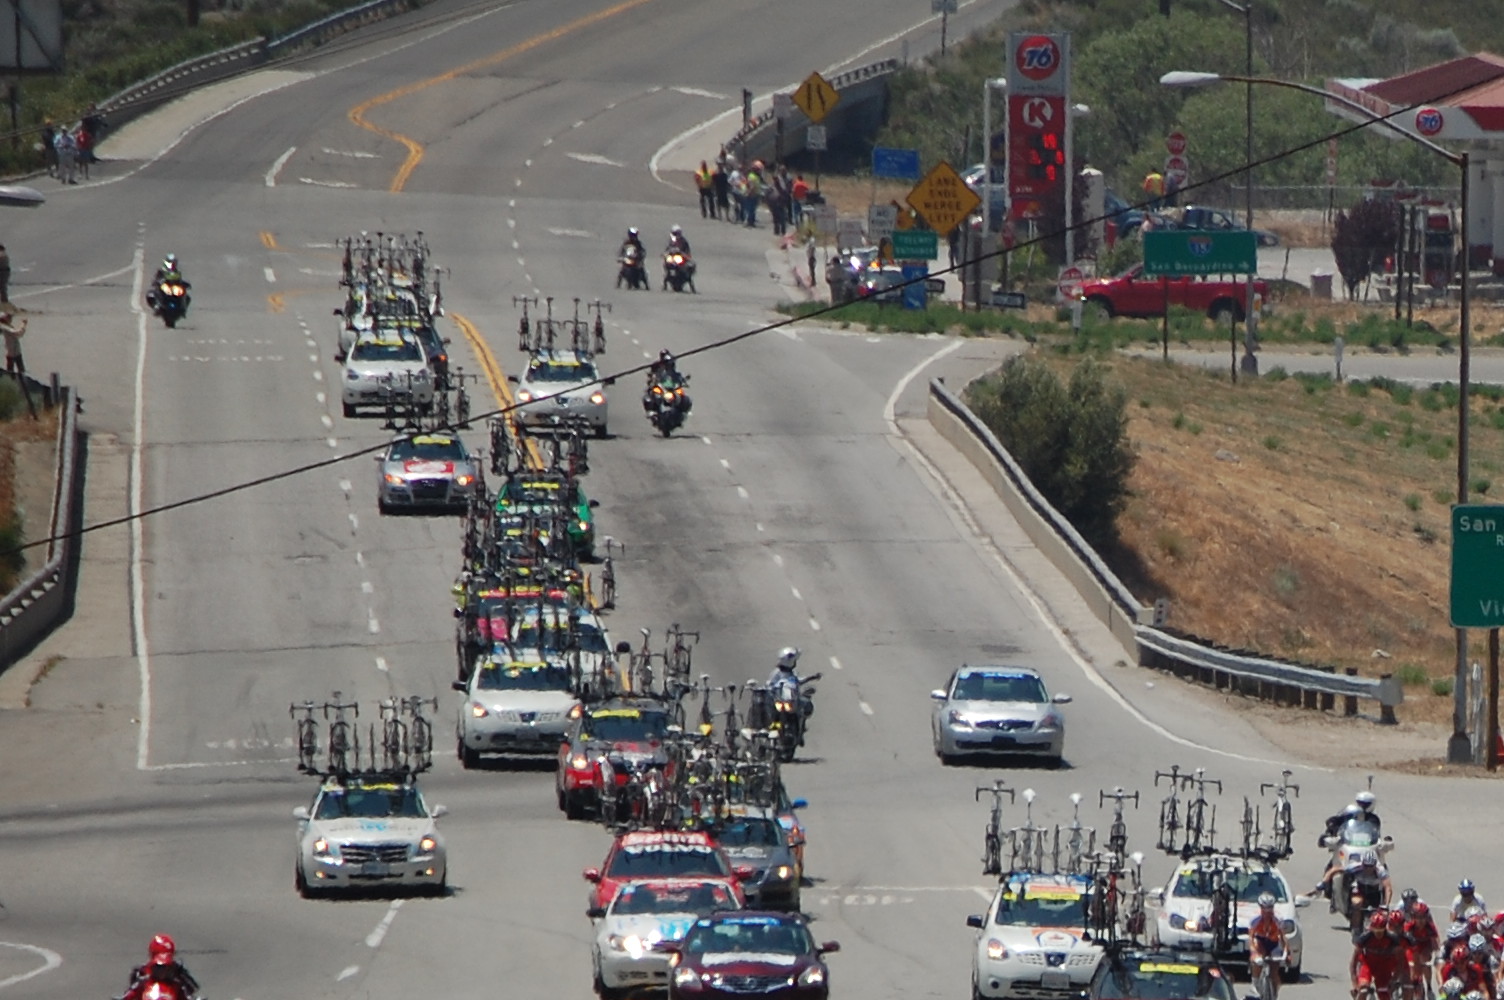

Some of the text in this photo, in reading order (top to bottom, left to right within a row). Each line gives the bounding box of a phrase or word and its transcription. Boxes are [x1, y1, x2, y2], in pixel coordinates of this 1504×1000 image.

[1024, 48, 1054, 69] 76
[1420, 115, 1439, 130] 76
[1459, 516, 1496, 532] San
[624, 844, 712, 854] VOLVO
